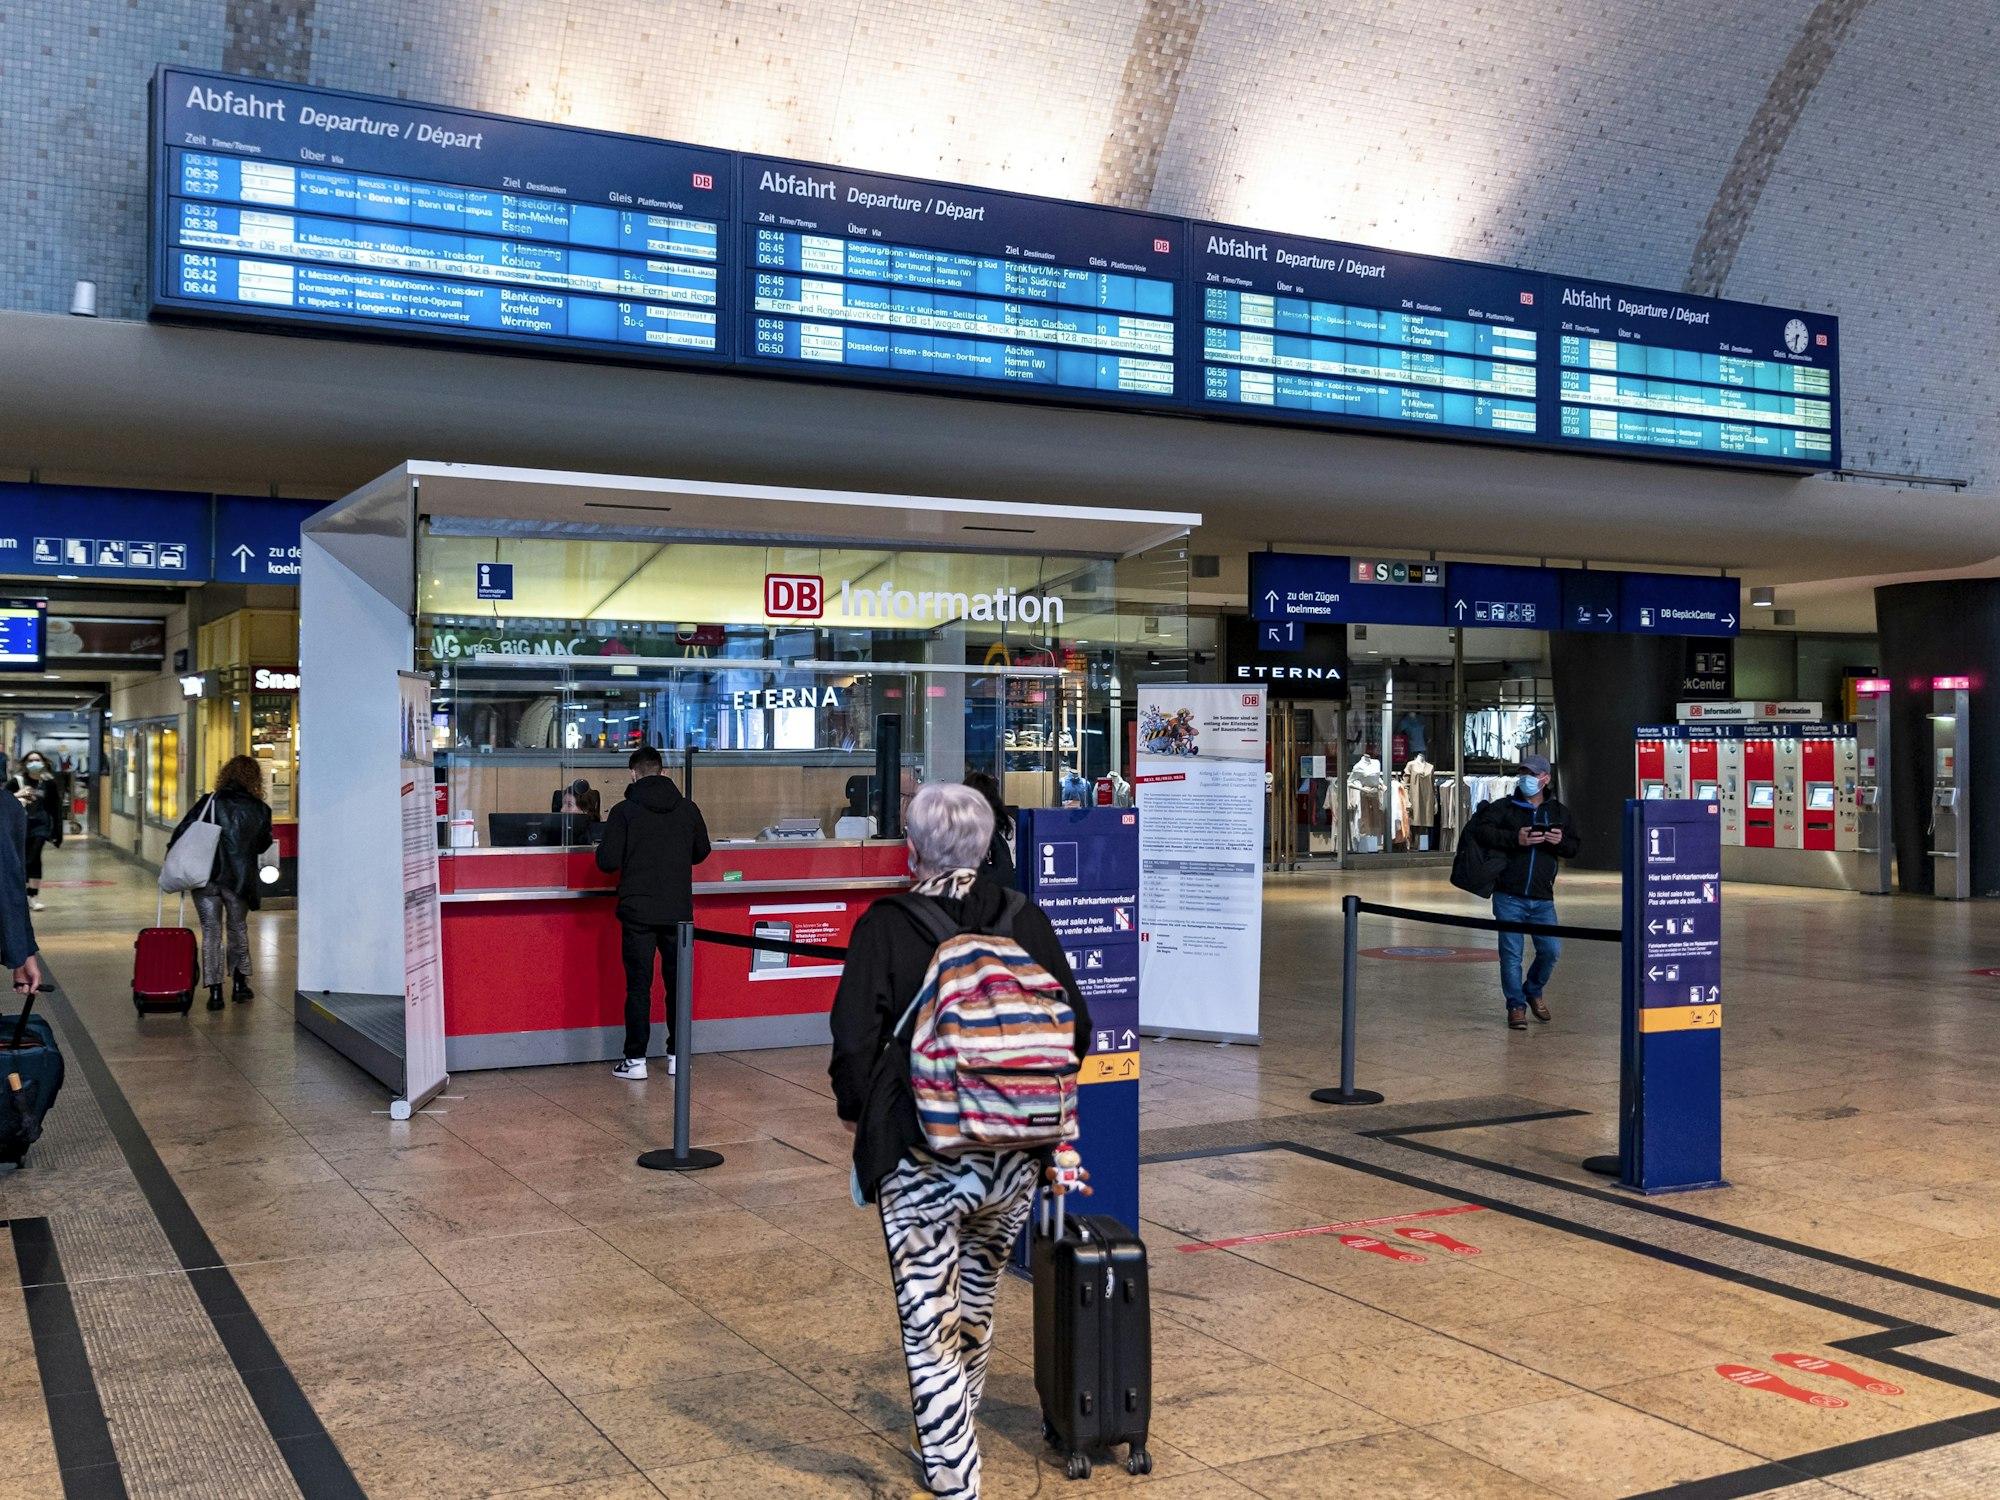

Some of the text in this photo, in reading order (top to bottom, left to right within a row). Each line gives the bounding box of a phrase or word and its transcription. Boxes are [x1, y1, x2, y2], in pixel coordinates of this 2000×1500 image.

[186, 84, 286, 121] Abfahrt
[299, 106, 399, 140] Departure
[416, 122, 482, 153] Départ
[185, 132, 207, 145] Zeit
[300, 146, 344, 164] Über Via
[503, 176, 521, 188] Ziel
[694, 173, 712, 189] DB
[760, 170, 836, 200] Abfahrt
[608, 191, 632, 204] Gleis
[847, 187, 922, 215] Departure
[935, 199, 984, 224] Départ
[758, 213, 775, 223] Zeit
[502, 221, 532, 234] Essen
[848, 223, 882, 237] Über Via
[758, 229, 784, 242] 06:44
[758, 241, 784, 253] 06:45
[1005, 245, 1019, 255] Ziel
[1154, 239, 1169, 252] DB
[1206, 235, 1267, 261] Abfahrt
[183, 254, 217, 267] 06:41
[501, 255, 541, 269] Koblenz
[758, 253, 784, 265] 06:45
[1088, 257, 1107, 267] Gleis
[1276, 249, 1335, 273] Departure
[1346, 259, 1385, 280] Départ
[183, 267, 217, 281] 06:42
[758, 274, 784, 286] 06:46
[1004, 273, 1028, 284] Berlin
[1206, 272, 1220, 282] Zeit
[183, 281, 216, 294] 06:44
[758, 285, 784, 298] 06:47
[1004, 284, 1046, 297] Paris Nord
[501, 290, 563, 308] Blankenberg
[1402, 299, 1414, 308] Ziel
[1521, 293, 1533, 304] DB
[1561, 287, 1611, 310] Abfahrt
[500, 303, 539, 315] Krefeld
[1004, 303, 1021, 313] Kall
[1617, 299, 1667, 320] Departure
[1676, 307, 1710, 326] Départ
[501, 315, 551, 331] Worringen
[758, 318, 784, 330] 06:48
[1004, 315, 1077, 331] Bergisch Gladbach
[758, 330, 784, 342] 06:49
[758, 342, 784, 354] 06:50
[1004, 345, 1034, 356] Aachen
[1004, 356, 1045, 368] Hamm (W)
[1004, 367, 1033, 378] Horrem
[269, 547, 284, 557] zu
[1376, 564, 1388, 581] S
[769, 577, 1064, 623] DB Information
[1287, 591, 1339, 602] zu den Zügen
[1287, 604, 1331, 614] koelnmesse
[1476, 610, 1487, 618] WC
[1661, 609, 1671, 618] DB
[1286, 621, 1293, 642] 1
[1238, 666, 1340, 679] ETERNA
[734, 686, 838, 710] ETERNA
[1244, 695, 1258, 706] DB
[1123, 815, 1134, 824] DB
[1672, 872, 1718, 880] Fahrkartenverkauf
[1056, 898, 1071, 906] kein
[1073, 895, 1135, 905] Fahrkartenverkauf
